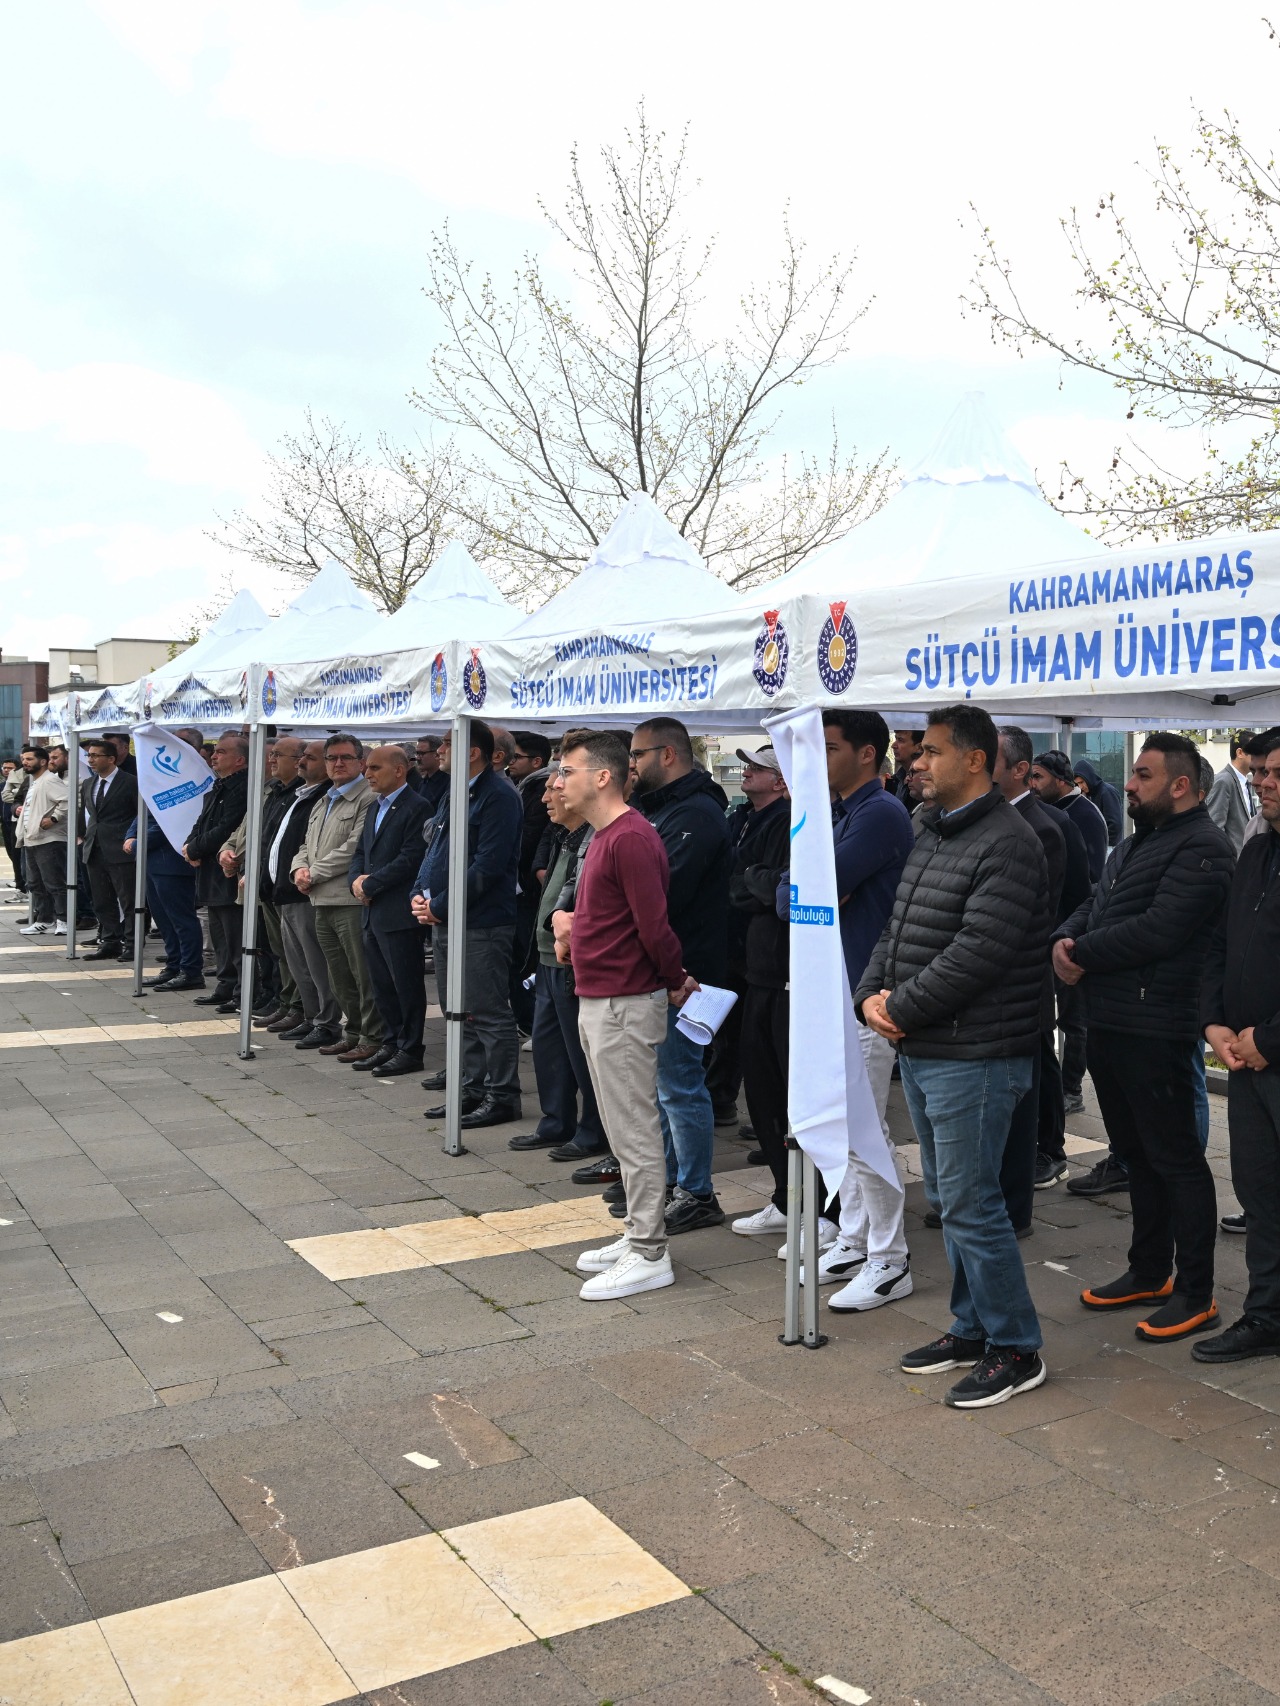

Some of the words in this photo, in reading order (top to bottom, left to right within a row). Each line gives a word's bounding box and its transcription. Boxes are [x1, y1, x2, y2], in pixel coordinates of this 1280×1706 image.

[1009, 550, 1254, 615] KAHRAMANMARAŞ
[555, 632, 656, 662] KAHRAMANMARAŞ
[905, 627, 1000, 698] SÜTÇÜ
[1010, 624, 1102, 684] İMAM
[510, 670, 554, 715] SÜTÇÜ
[557, 669, 596, 708] İMAM
[600, 655, 718, 705] ÜNİVERSİTESİ
